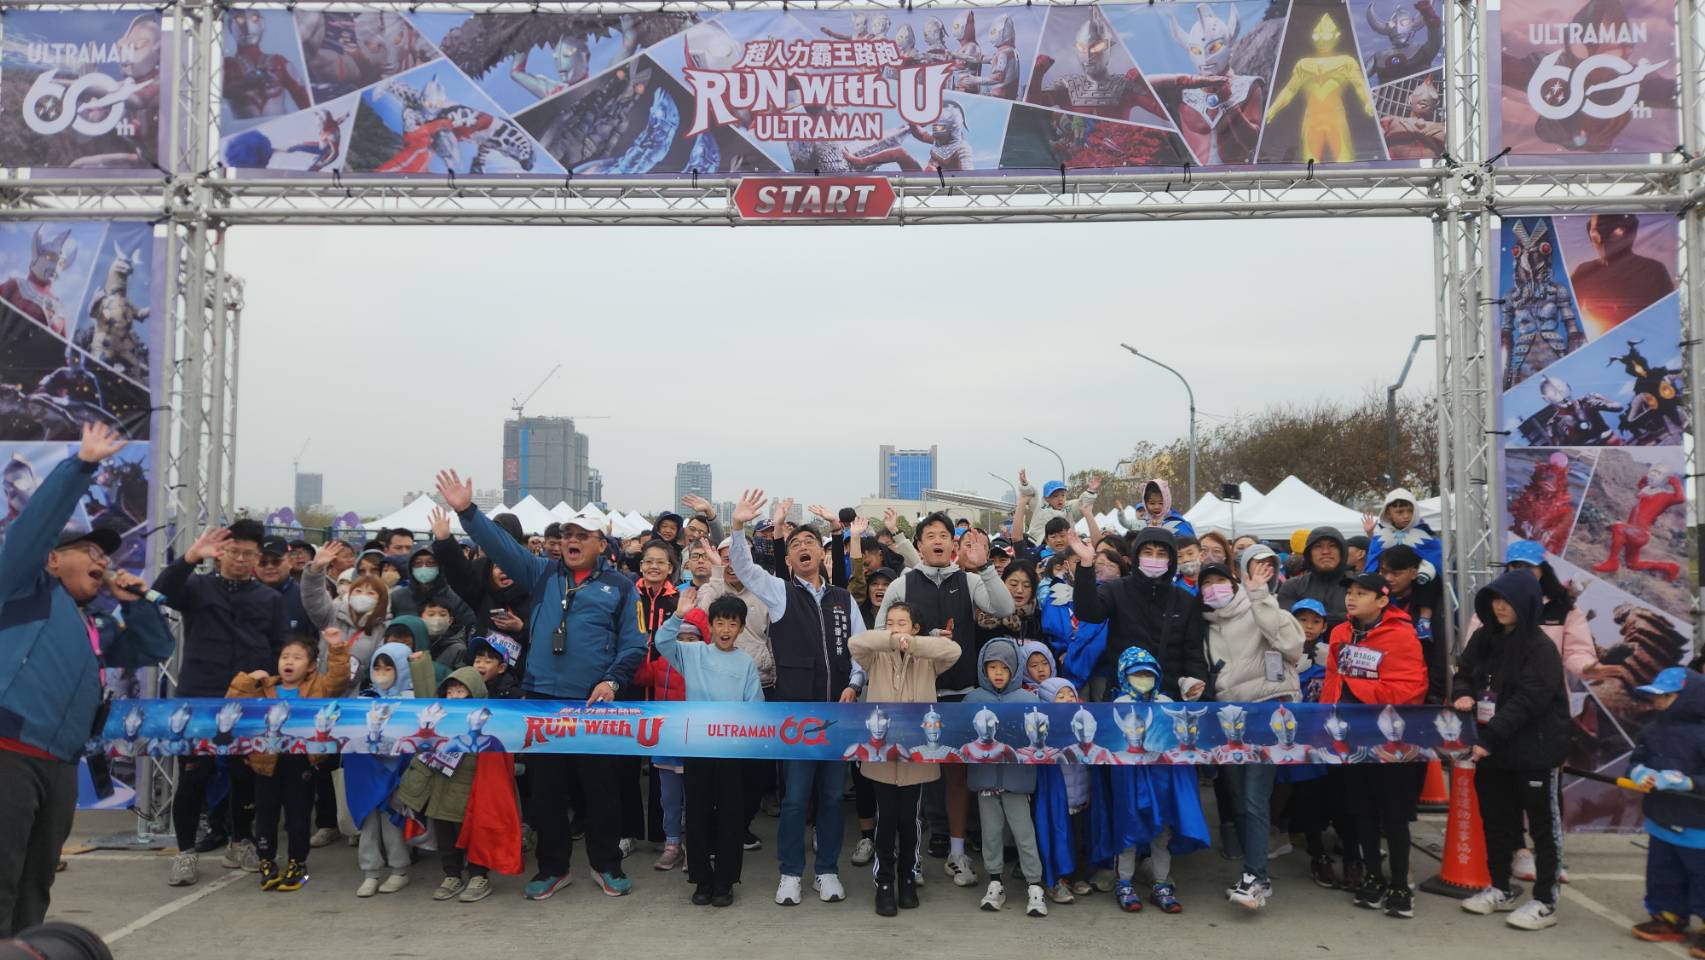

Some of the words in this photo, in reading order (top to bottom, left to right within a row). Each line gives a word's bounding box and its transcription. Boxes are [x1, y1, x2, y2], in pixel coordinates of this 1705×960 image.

[1528, 22, 1648, 45] ULTRAMAN
[27, 43, 136, 64] ULTRAMAN
[744, 41, 902, 68] 超人力霸王路跑
[684, 68, 789, 139] RUN
[897, 61, 954, 125] U
[755, 113, 883, 141] ULTRAMAN
[755, 183, 877, 214] START
[522, 716, 578, 749] RUN
[637, 716, 666, 748] U
[707, 723, 776, 738] ULTRAMAN
